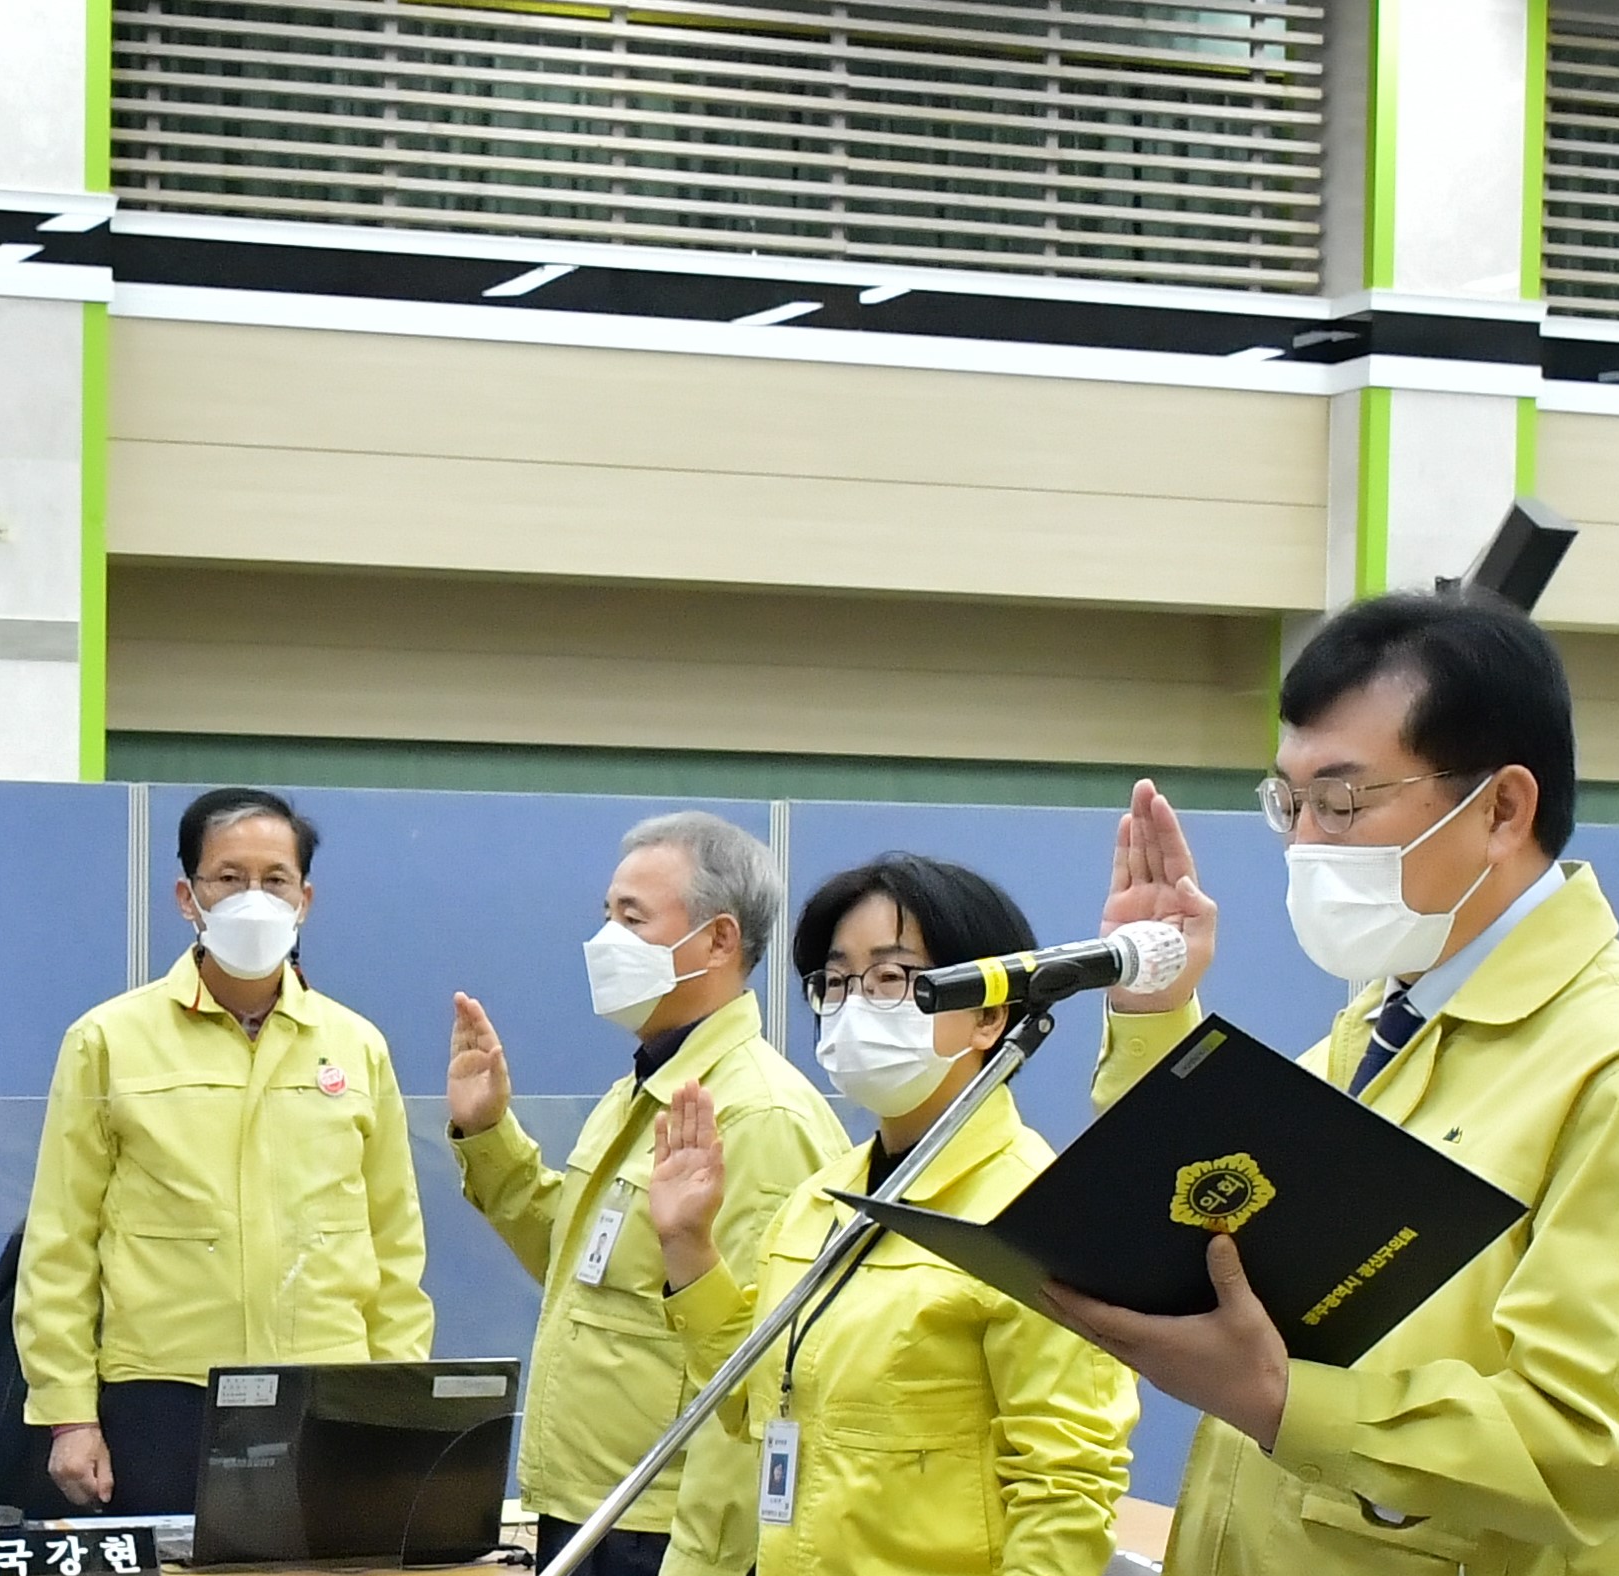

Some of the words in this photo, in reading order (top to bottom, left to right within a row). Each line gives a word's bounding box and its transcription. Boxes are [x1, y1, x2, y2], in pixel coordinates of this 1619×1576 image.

[1199, 1174, 1245, 1211] 의회
[1301, 1275, 1363, 1325] 광주광역시
[1356, 1226, 1419, 1278] 광산구의회
